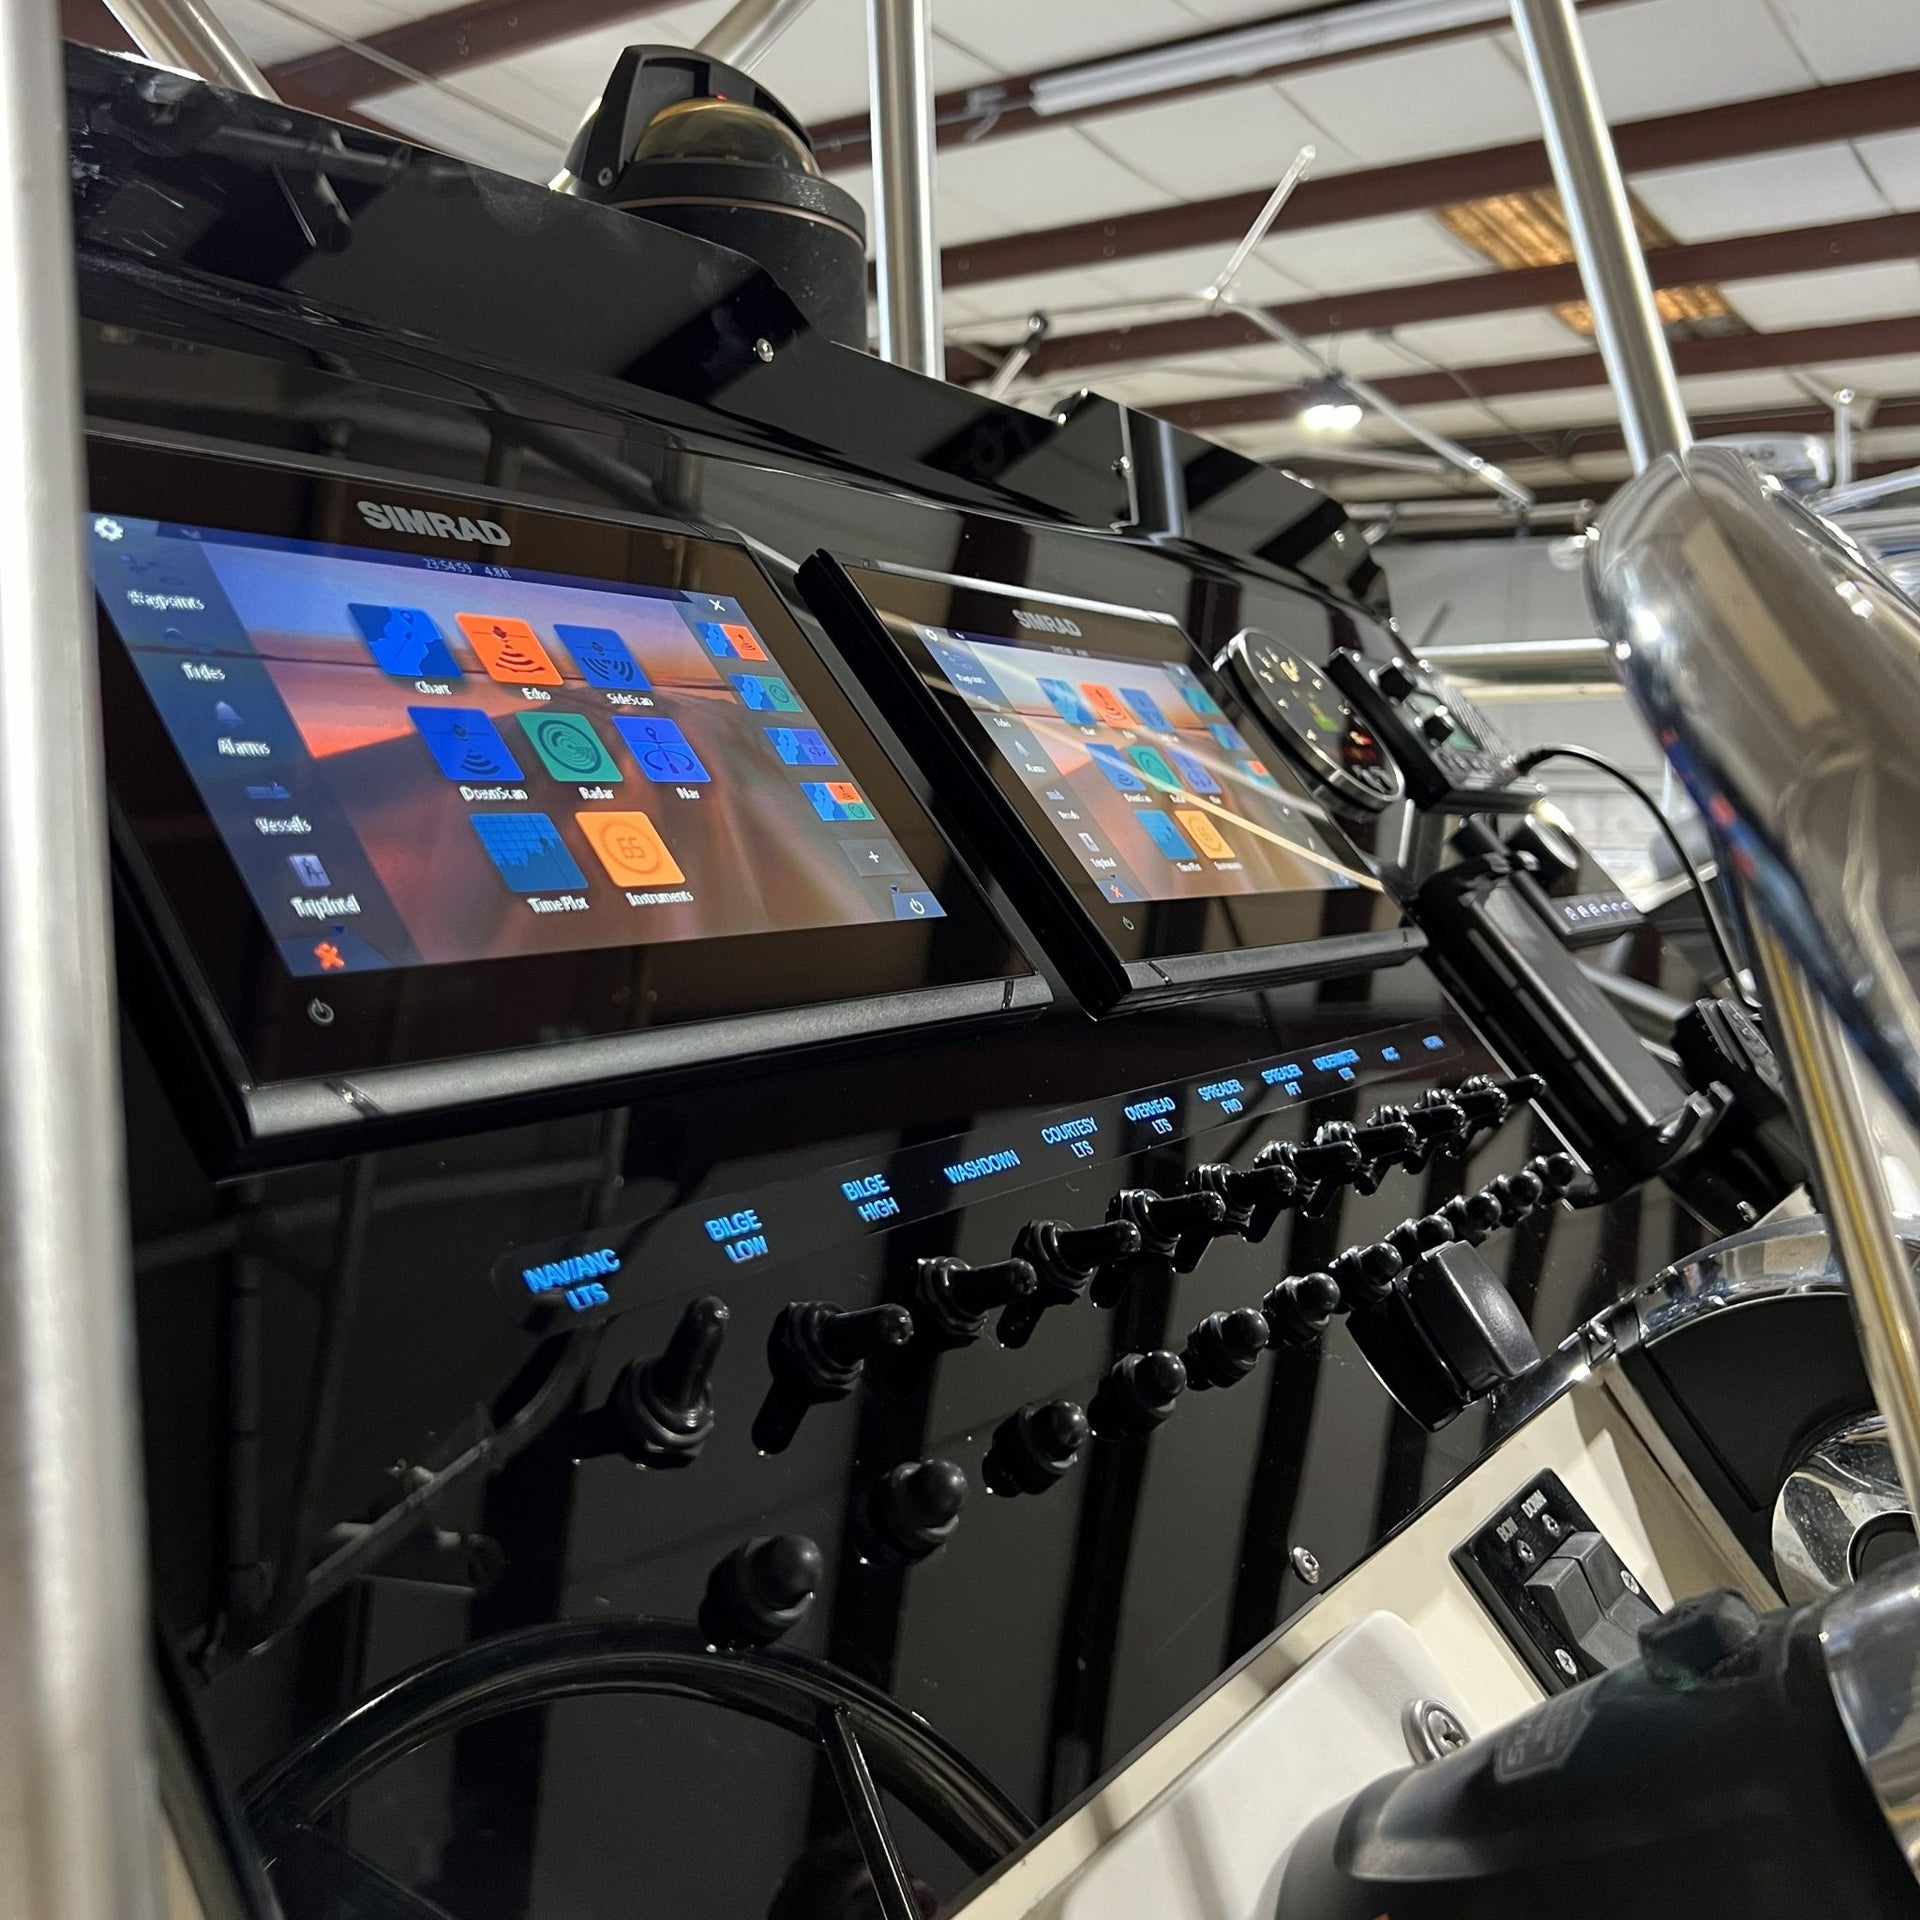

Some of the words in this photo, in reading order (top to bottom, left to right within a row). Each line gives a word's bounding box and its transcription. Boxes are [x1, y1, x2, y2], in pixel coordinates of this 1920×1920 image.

[357, 501, 512, 547] SIMRAD
[127, 589, 205, 611] Waypoints
[1012, 609, 1082, 637] SIMRAD
[181, 661, 226, 681] Tides
[415, 680, 452, 697] Chart
[522, 686, 551, 701] Echo
[606, 692, 654, 707] SideScan
[217, 737, 270, 758] Alarms
[459, 785, 528, 802] DownScan
[578, 786, 614, 801] Radar
[255, 814, 312, 836] Vessels
[527, 895, 590, 914] TimePlot
[625, 890, 694, 906] Instruments
[1197, 1078, 1244, 1102] SPREADER
[1124, 1096, 1176, 1122] OVERHEAD
[1041, 1117, 1098, 1145] COURTESY
[1152, 1117, 1172, 1135] LTS
[1070, 1140, 1094, 1159] LTS
[943, 1149, 1021, 1184] WASHDOWN
[841, 1173, 890, 1201] BILGE
[857, 1196, 900, 1222] HIGH
[705, 1209, 763, 1242] BILGE
[724, 1235, 769, 1264] LOW
[565, 1282, 610, 1311] LTS
[1521, 1489, 1547, 1518] DOWN
[1495, 1516, 1518, 1543] BOW
